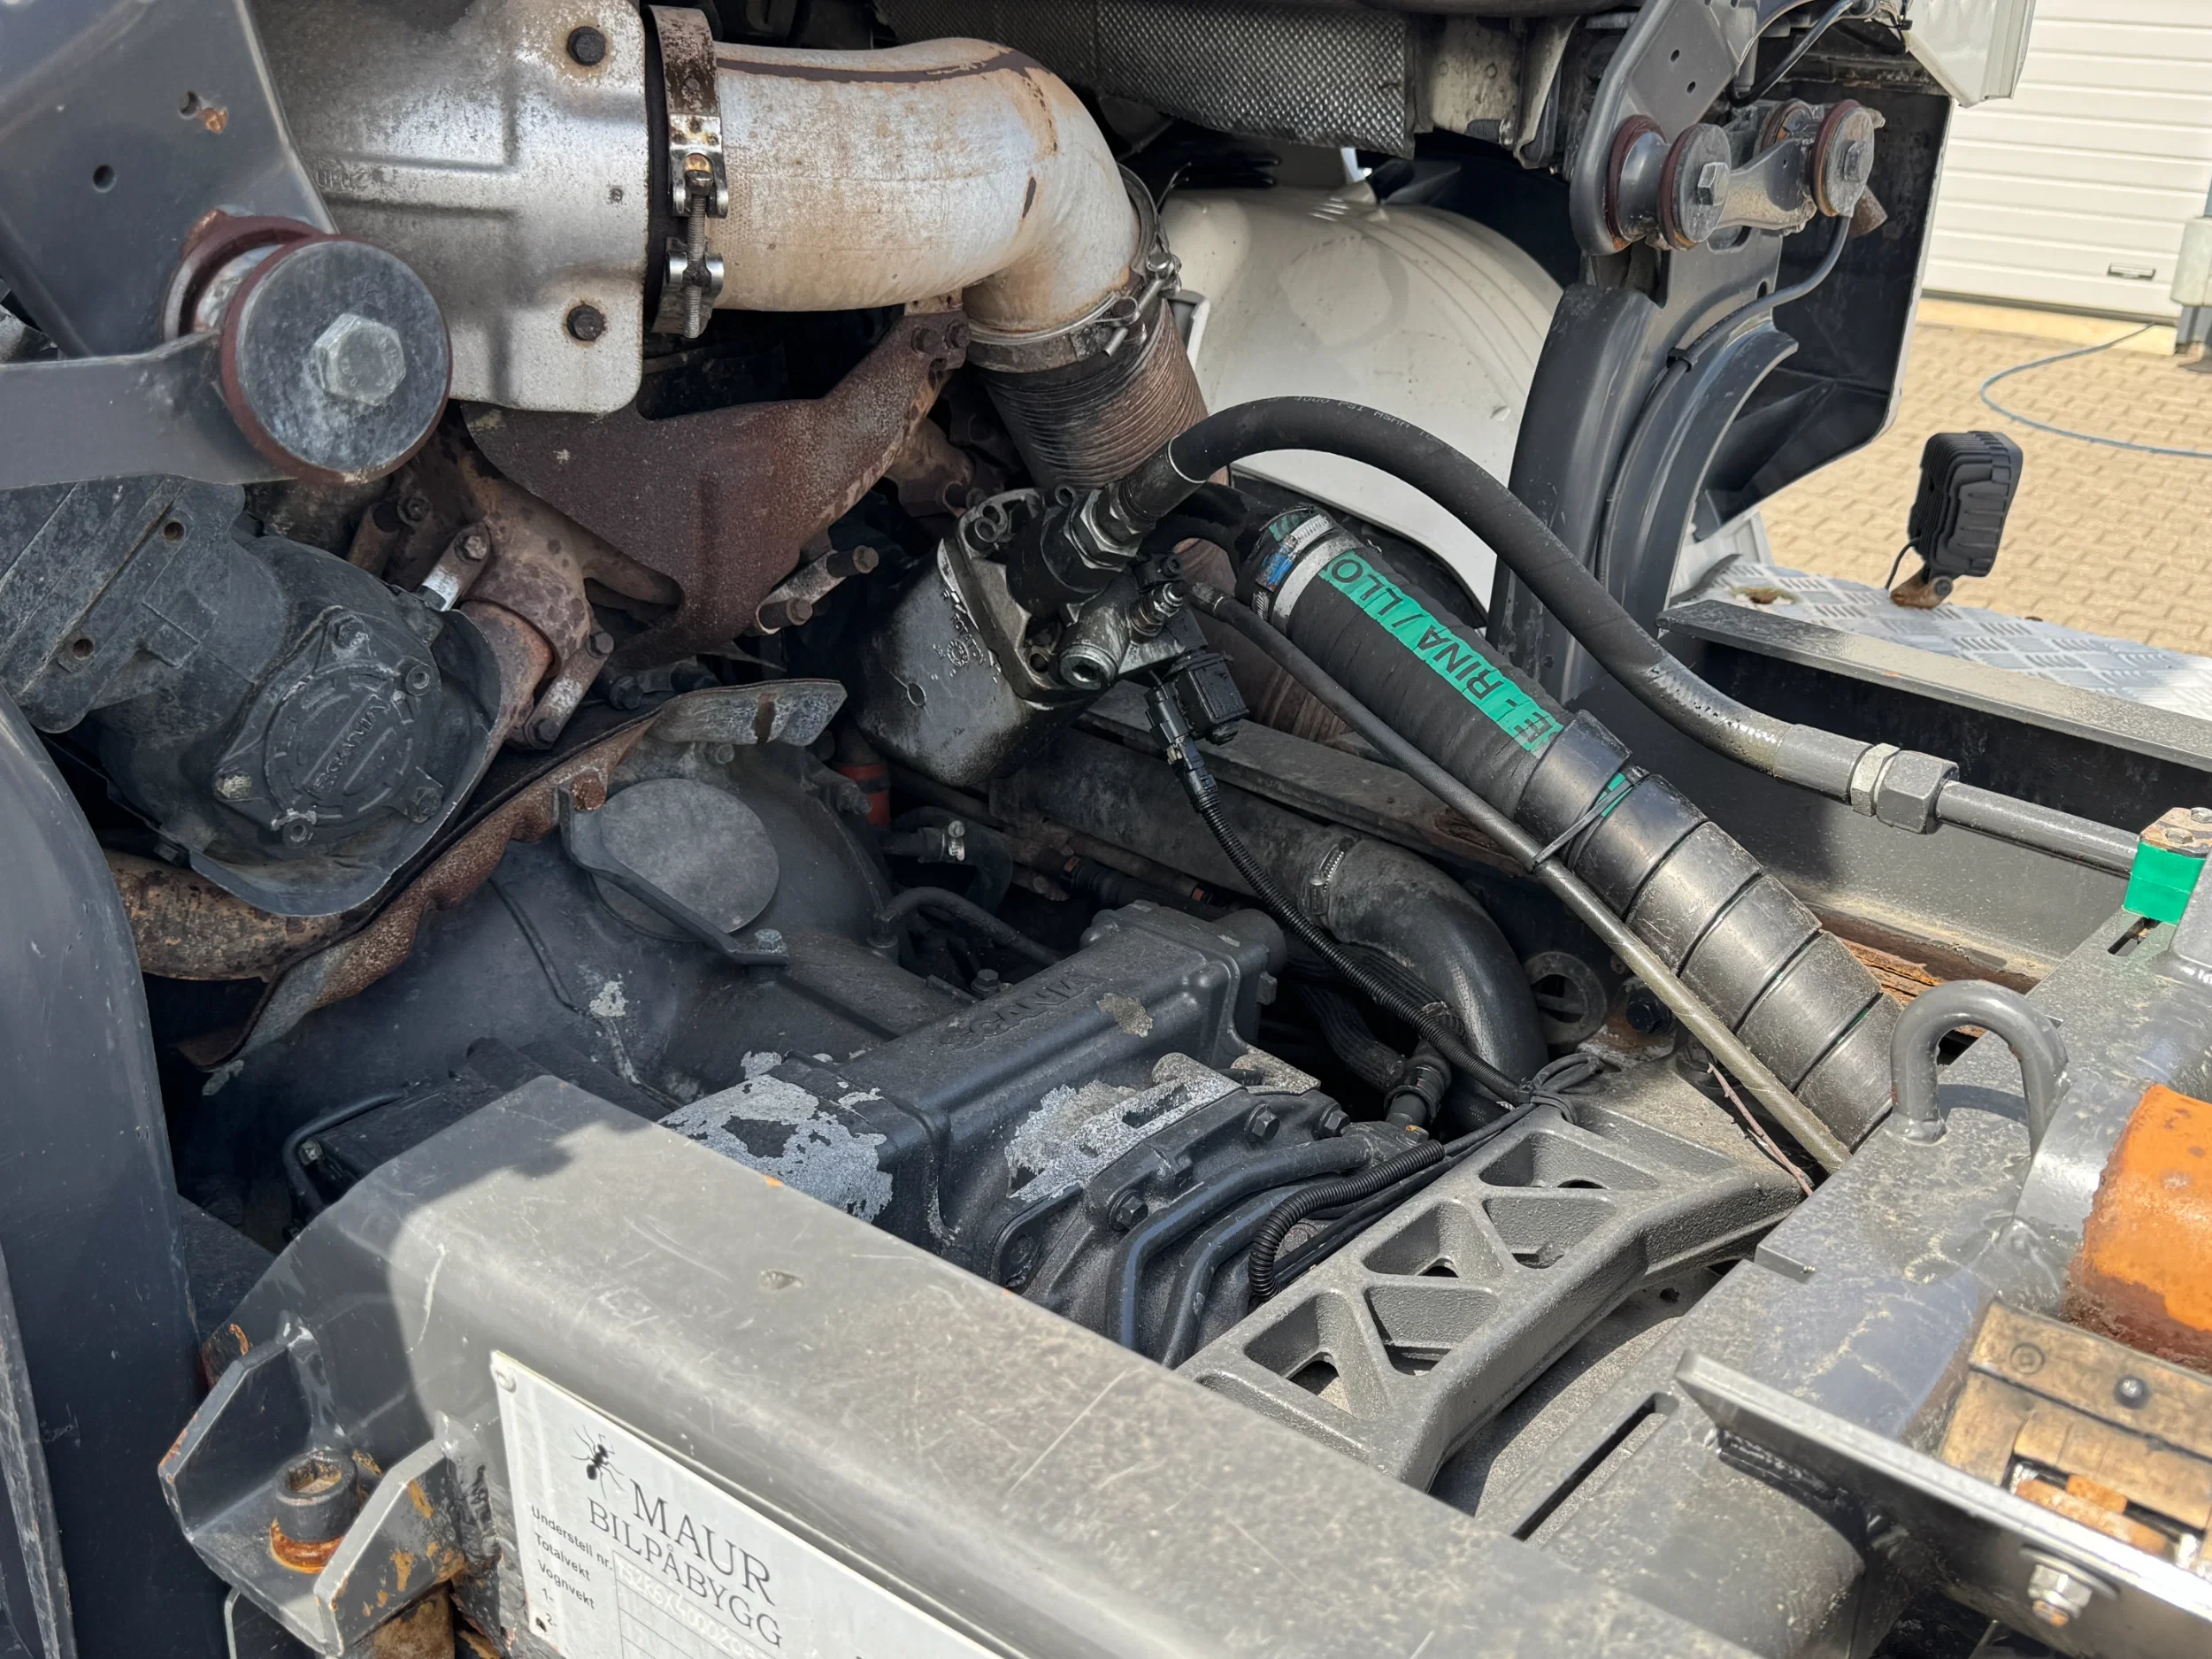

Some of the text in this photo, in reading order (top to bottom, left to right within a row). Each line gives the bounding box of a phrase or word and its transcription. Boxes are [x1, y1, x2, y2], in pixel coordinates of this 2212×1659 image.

[1326, 558, 1404, 617] LLO
[1416, 624, 1504, 699] RINA
[1514, 711, 1558, 742] E
[938, 972, 1106, 1052] SCANIA
[531, 1503, 613, 1571] Understell nr.
[534, 1532, 591, 1582] Totalvekt
[629, 1478, 776, 1607] MAUR
[537, 1558, 595, 1610] Vognvekt
[587, 1496, 783, 1649] BILPÅBYGG
